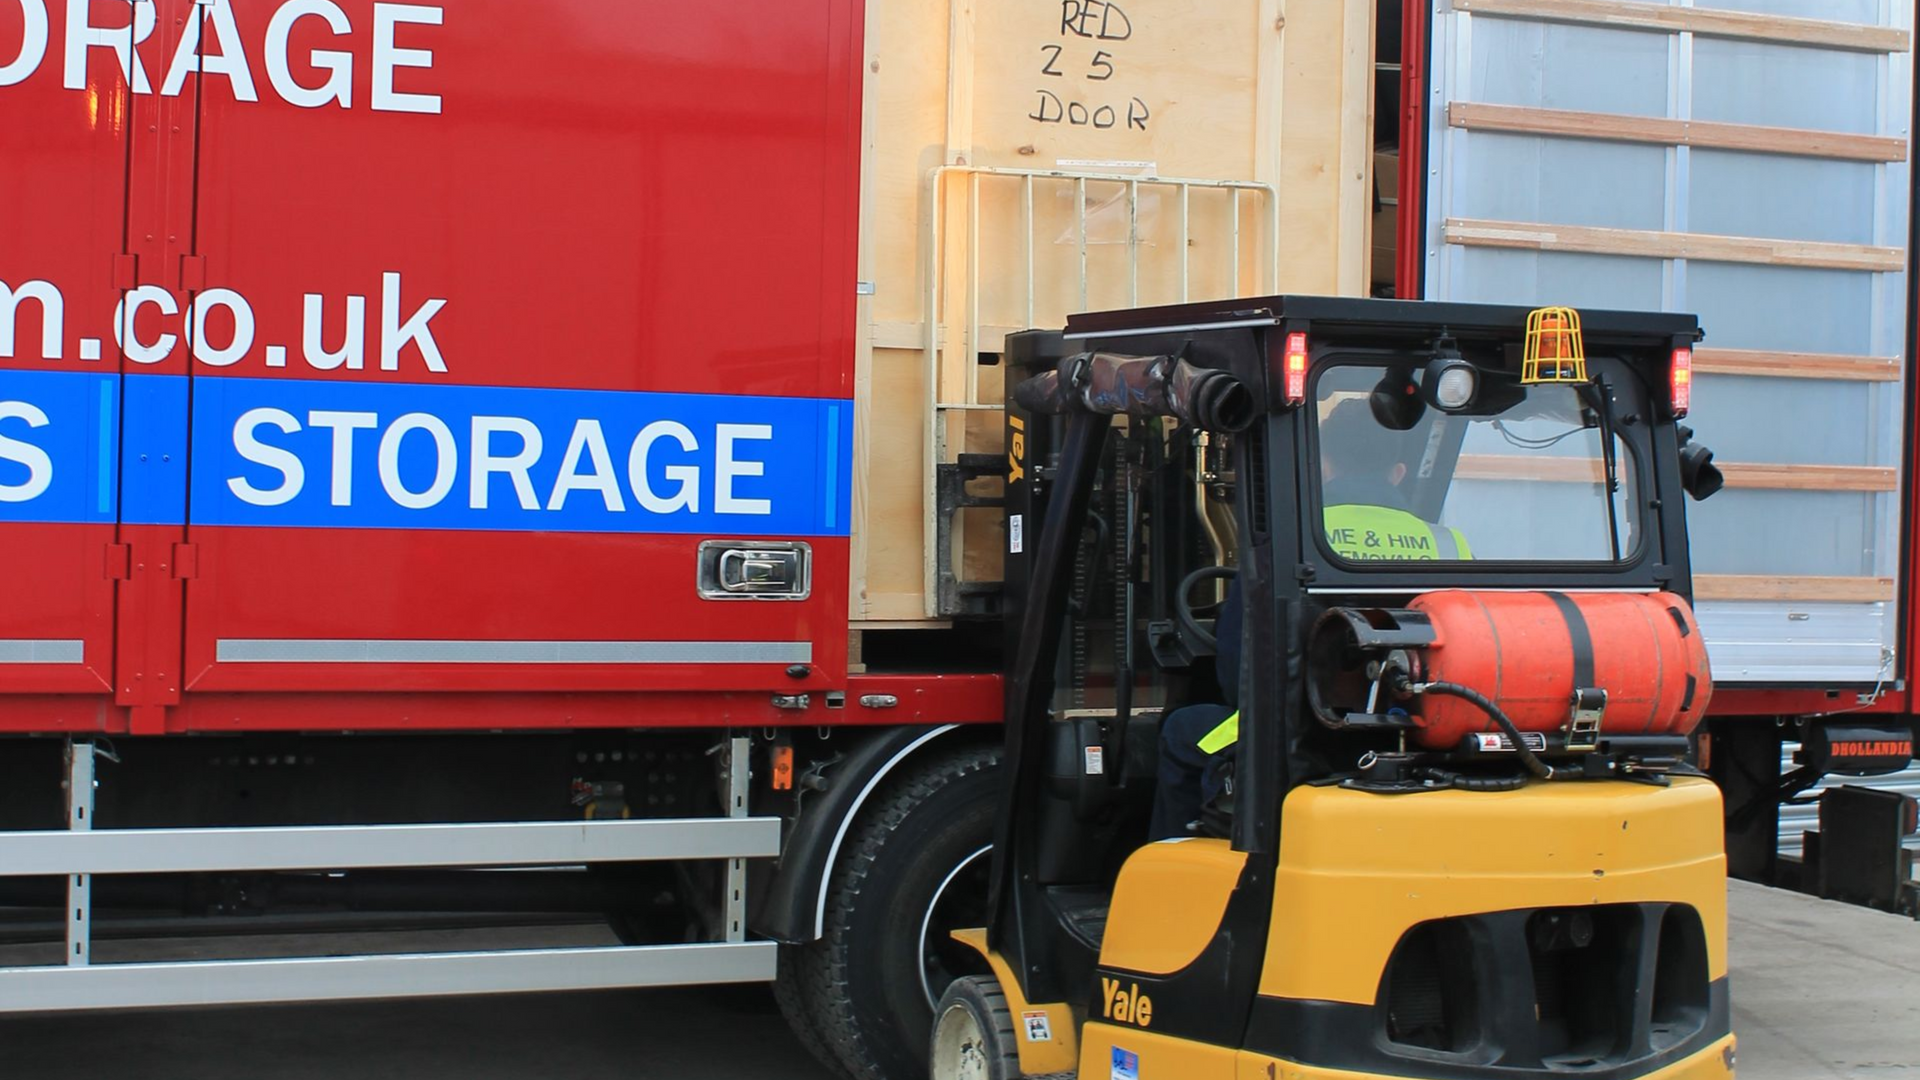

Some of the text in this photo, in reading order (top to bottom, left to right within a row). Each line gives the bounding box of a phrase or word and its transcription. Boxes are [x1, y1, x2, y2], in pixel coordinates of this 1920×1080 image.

[1061, 0, 1131, 40] RED
[1029, 90, 1149, 131] DOOR
[227, 405, 772, 515] STORAGE
[1325, 529, 1430, 550] ME & HIM
[1831, 741, 1912, 756] DHOLLANDIA
[1102, 977, 1152, 1027] Yale
